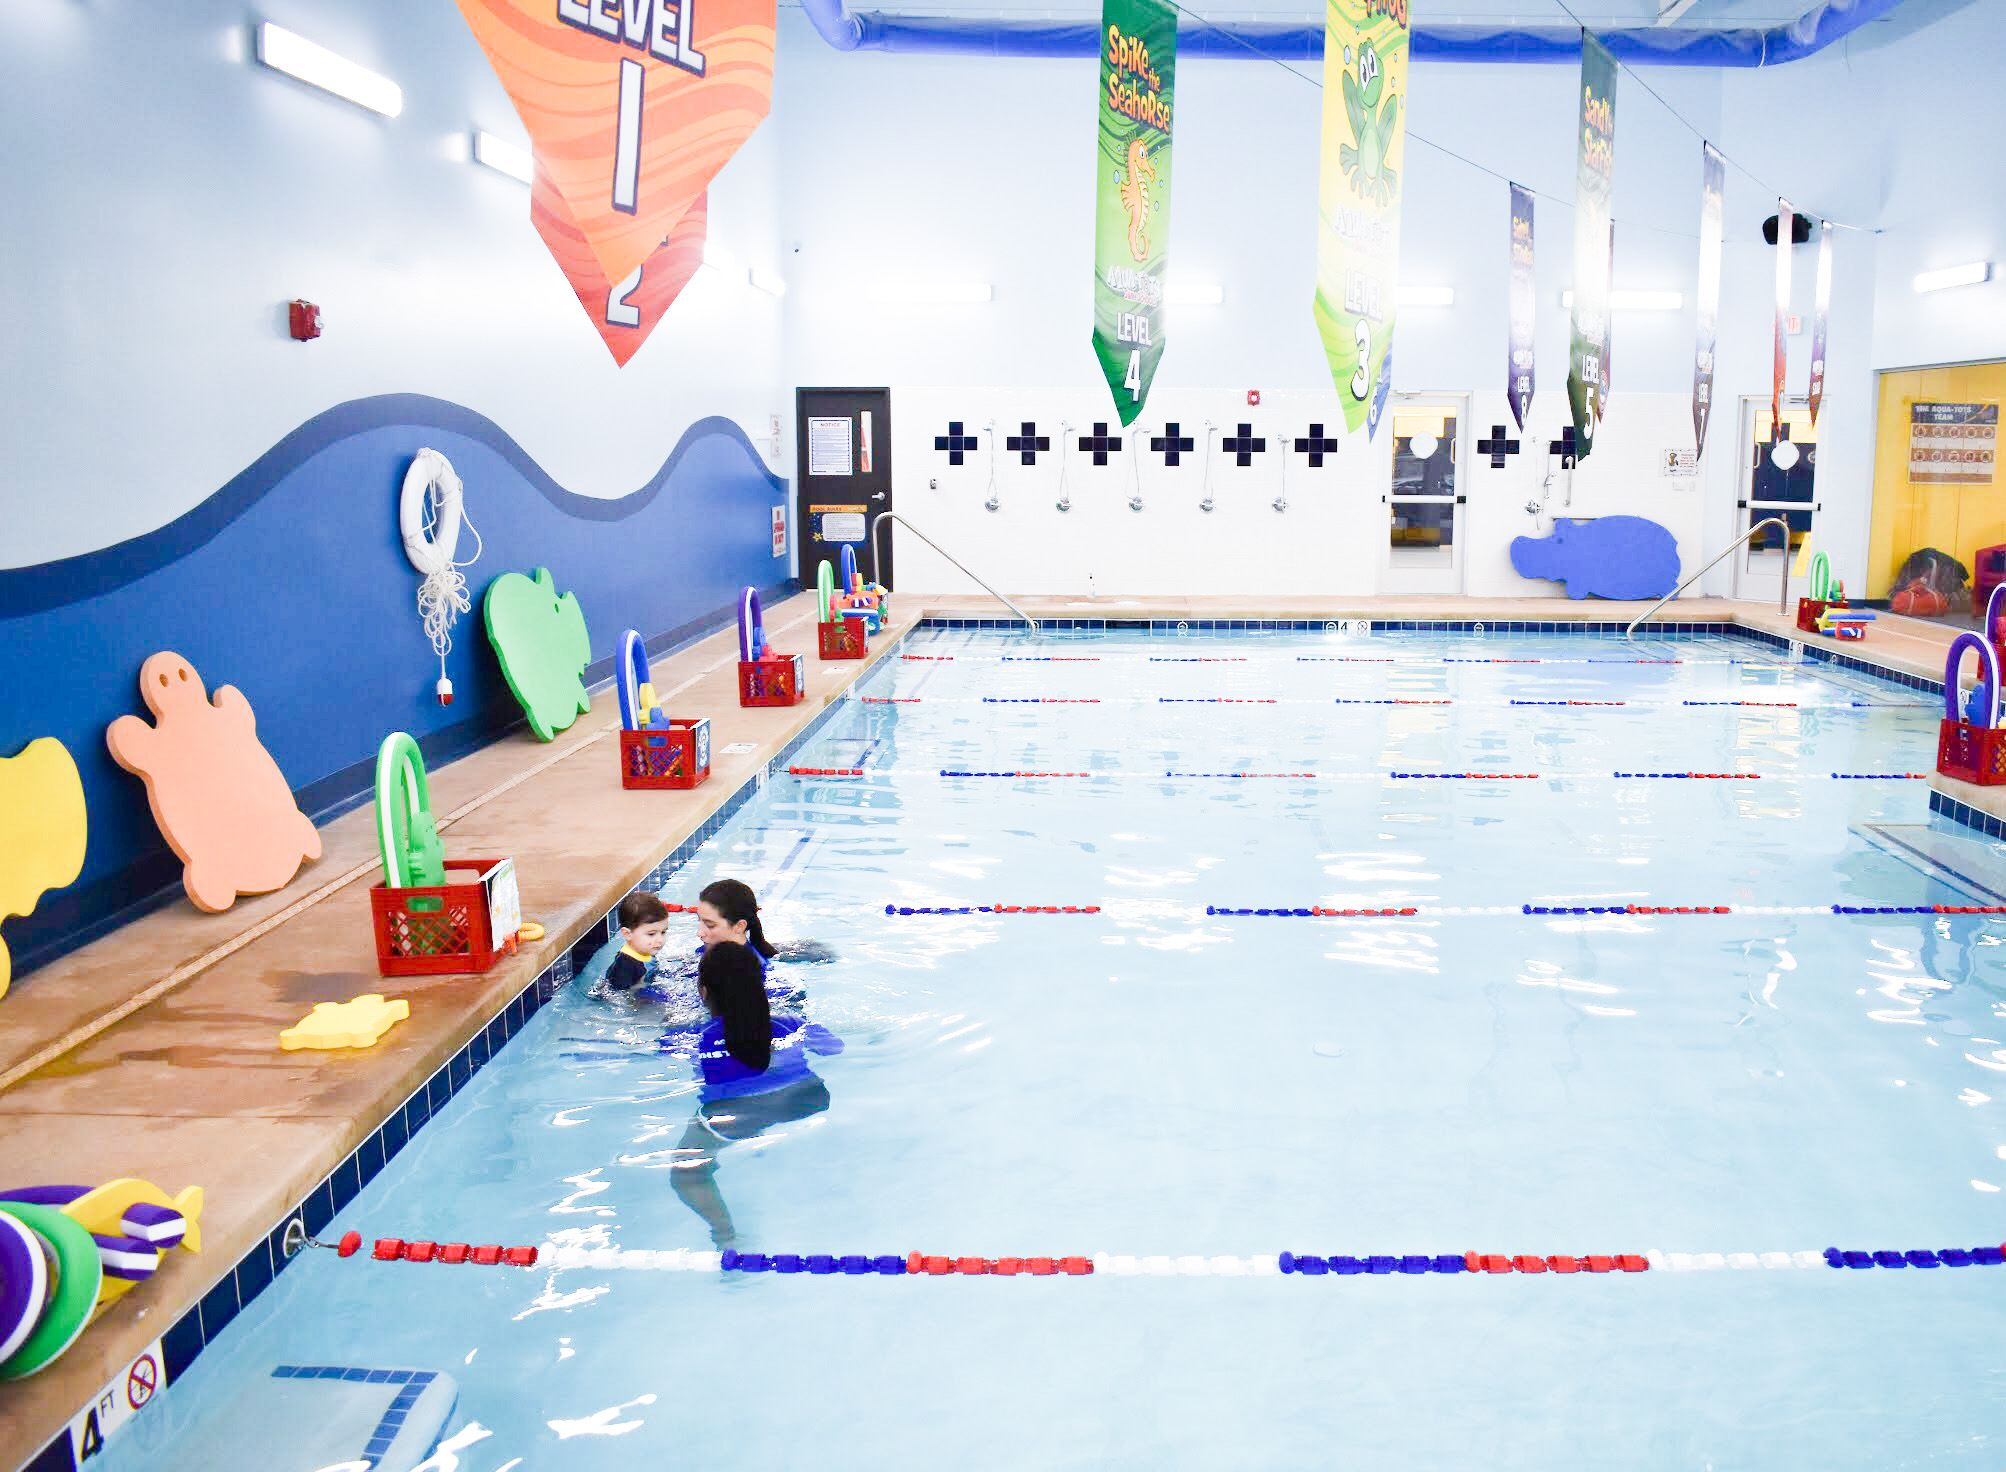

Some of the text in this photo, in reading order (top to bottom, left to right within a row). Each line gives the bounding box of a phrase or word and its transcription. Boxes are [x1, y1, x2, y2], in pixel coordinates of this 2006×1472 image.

[612, 57, 645, 216] 1
[1117, 312, 1152, 347] LEVEL
[1350, 319, 1371, 401] 3
[1124, 349, 1141, 402] 4
[1584, 386, 1594, 440] 5
[81, 1388, 114, 1462] 4 FT
